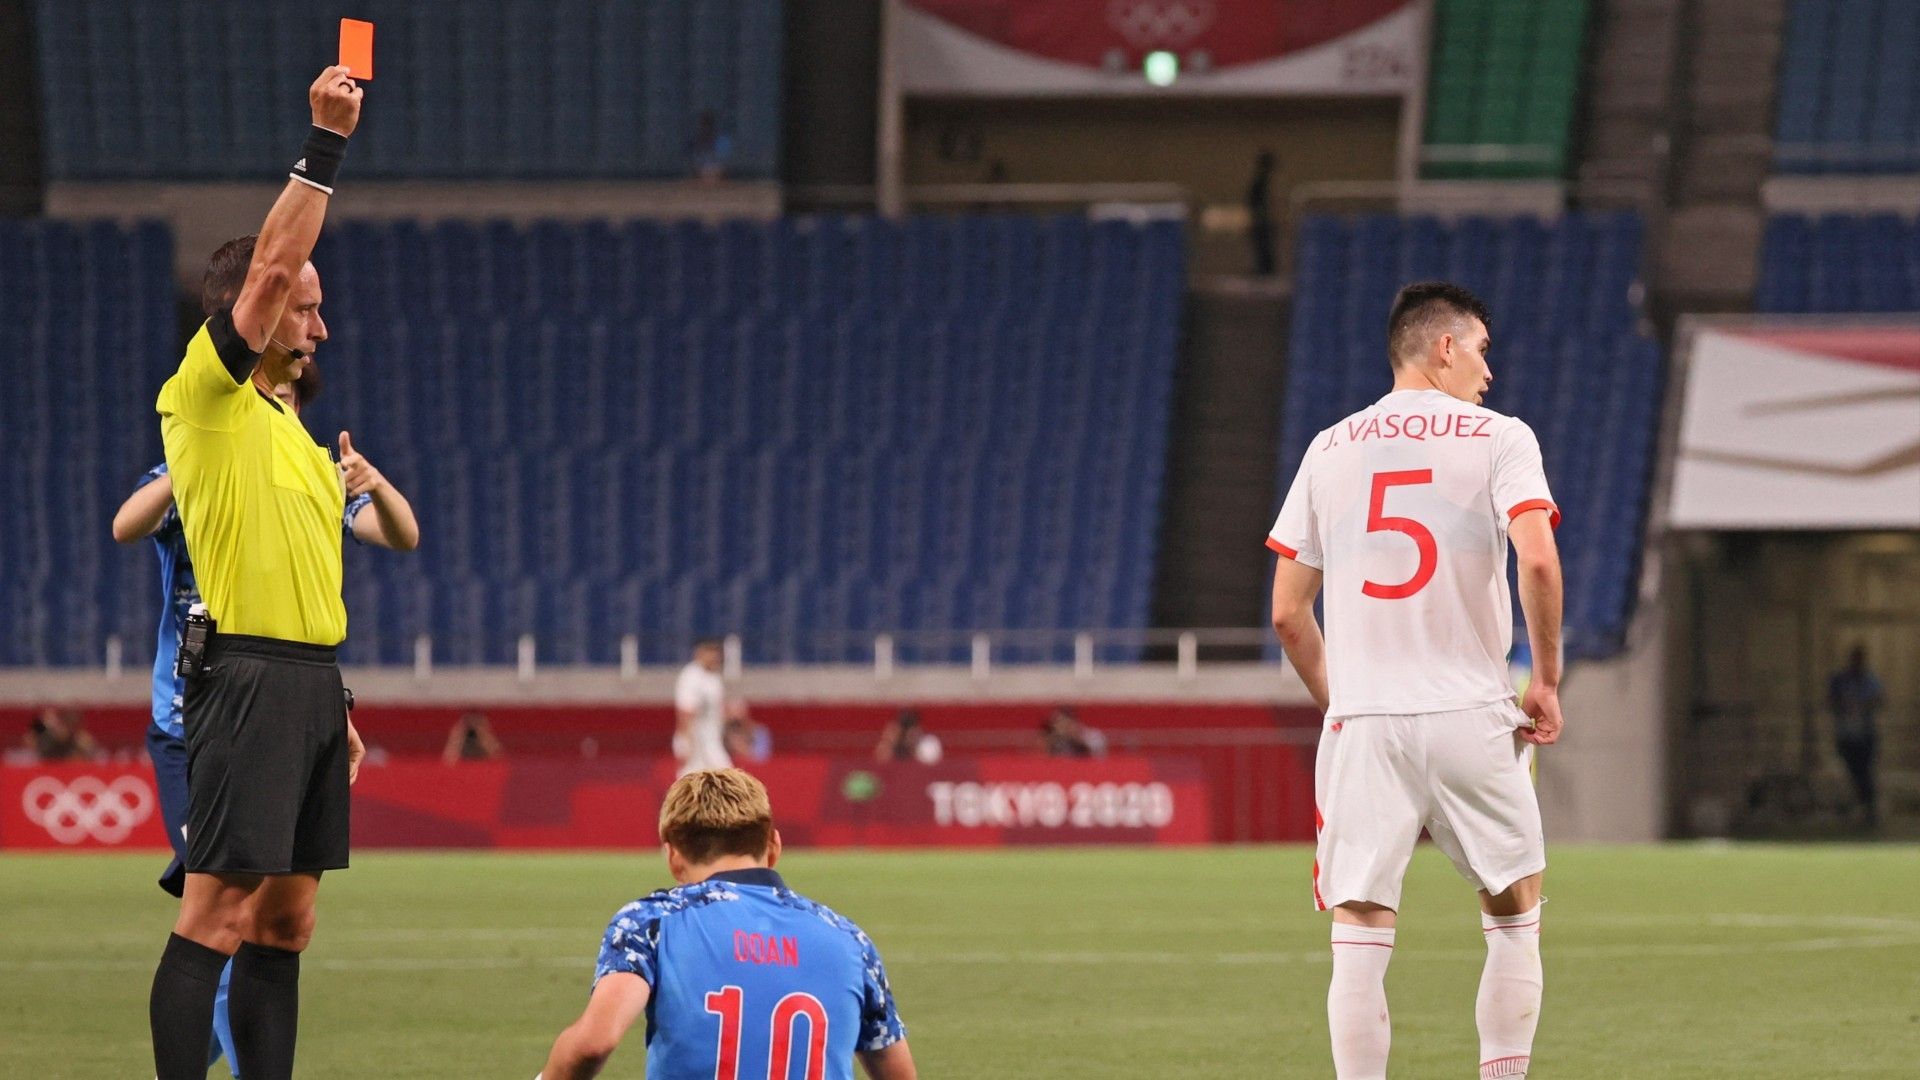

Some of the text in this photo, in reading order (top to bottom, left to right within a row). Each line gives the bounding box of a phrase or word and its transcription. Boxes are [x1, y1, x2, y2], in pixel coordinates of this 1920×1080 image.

[1322, 413, 1493, 451] J. VÁSQUEZ
[1361, 468, 1438, 600] 5
[928, 781, 1174, 827] TOKYO 2020
[733, 929, 799, 967] DOAN
[705, 985, 829, 1080] 10
